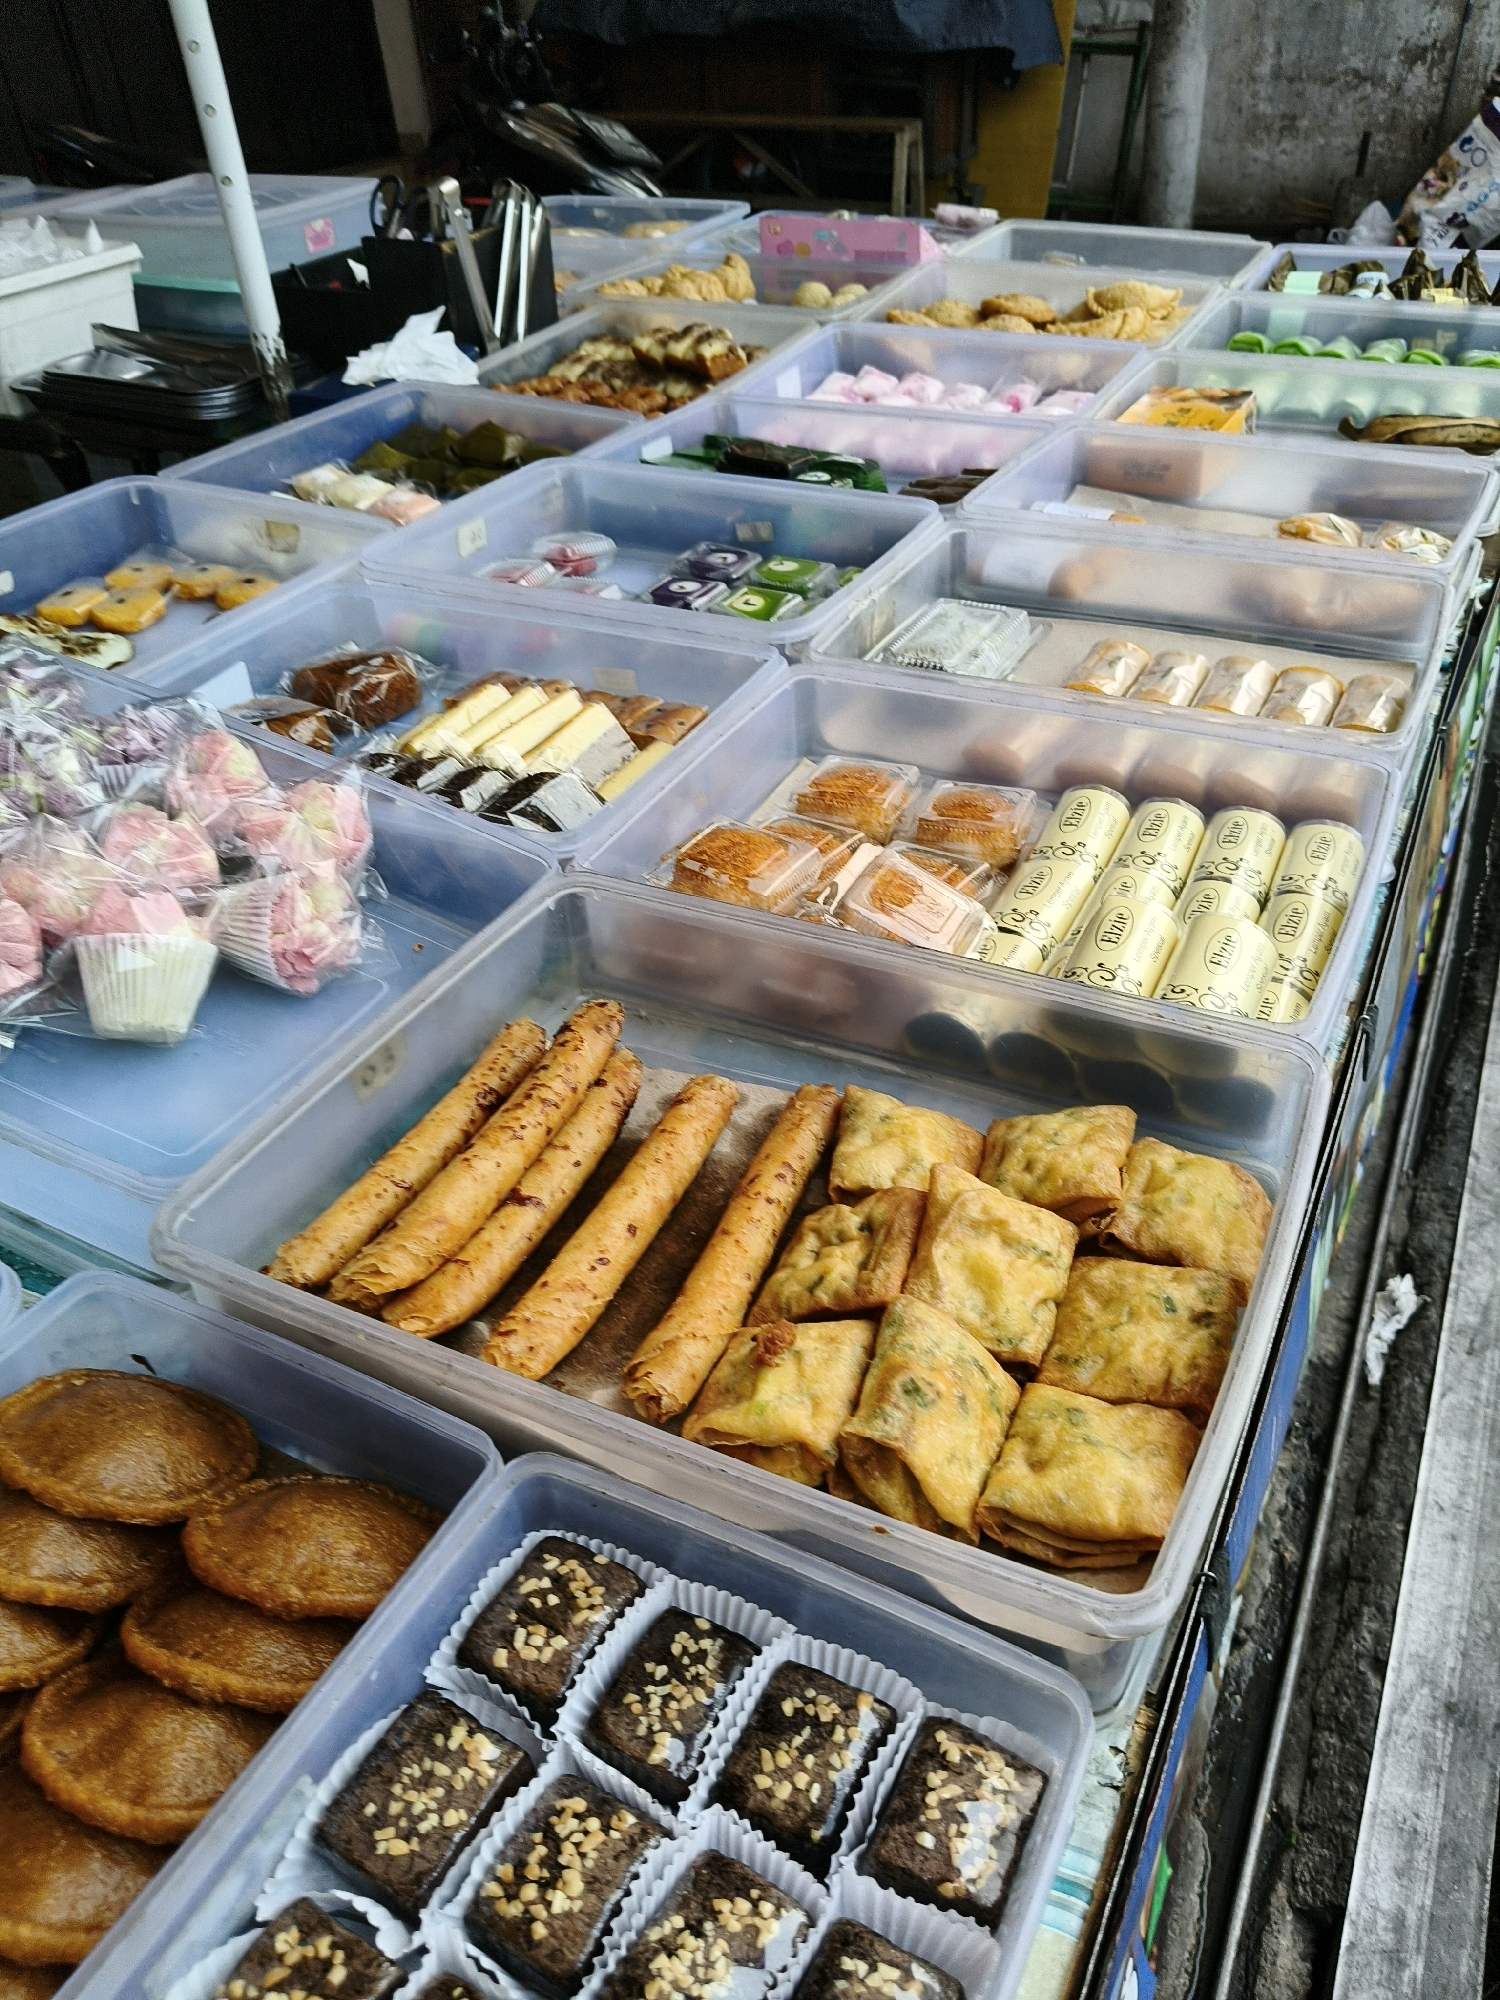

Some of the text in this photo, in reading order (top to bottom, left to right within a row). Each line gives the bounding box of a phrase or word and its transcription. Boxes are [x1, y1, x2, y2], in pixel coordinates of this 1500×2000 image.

[1063, 801, 1088, 828] Elzie
[1098, 802, 1112, 821] Ayam
[1177, 815, 1189, 831] Ayam
[1142, 813, 1167, 837] Elzie
[1222, 820, 1245, 844] Elzie
[1257, 822, 1268, 837] Ayam
[1311, 836, 1332, 860] Elzie
[1018, 871, 1049, 897] Elzie
[1057, 872, 1074, 888] Ayam
[1100, 912, 1130, 944] Elzie
[1143, 916, 1158, 938] Ayam
[1278, 907, 1305, 937] Elzie
[1317, 911, 1331, 931] Ayam
[1209, 934, 1239, 969] Elzie
[1250, 942, 1266, 964] Ayam
